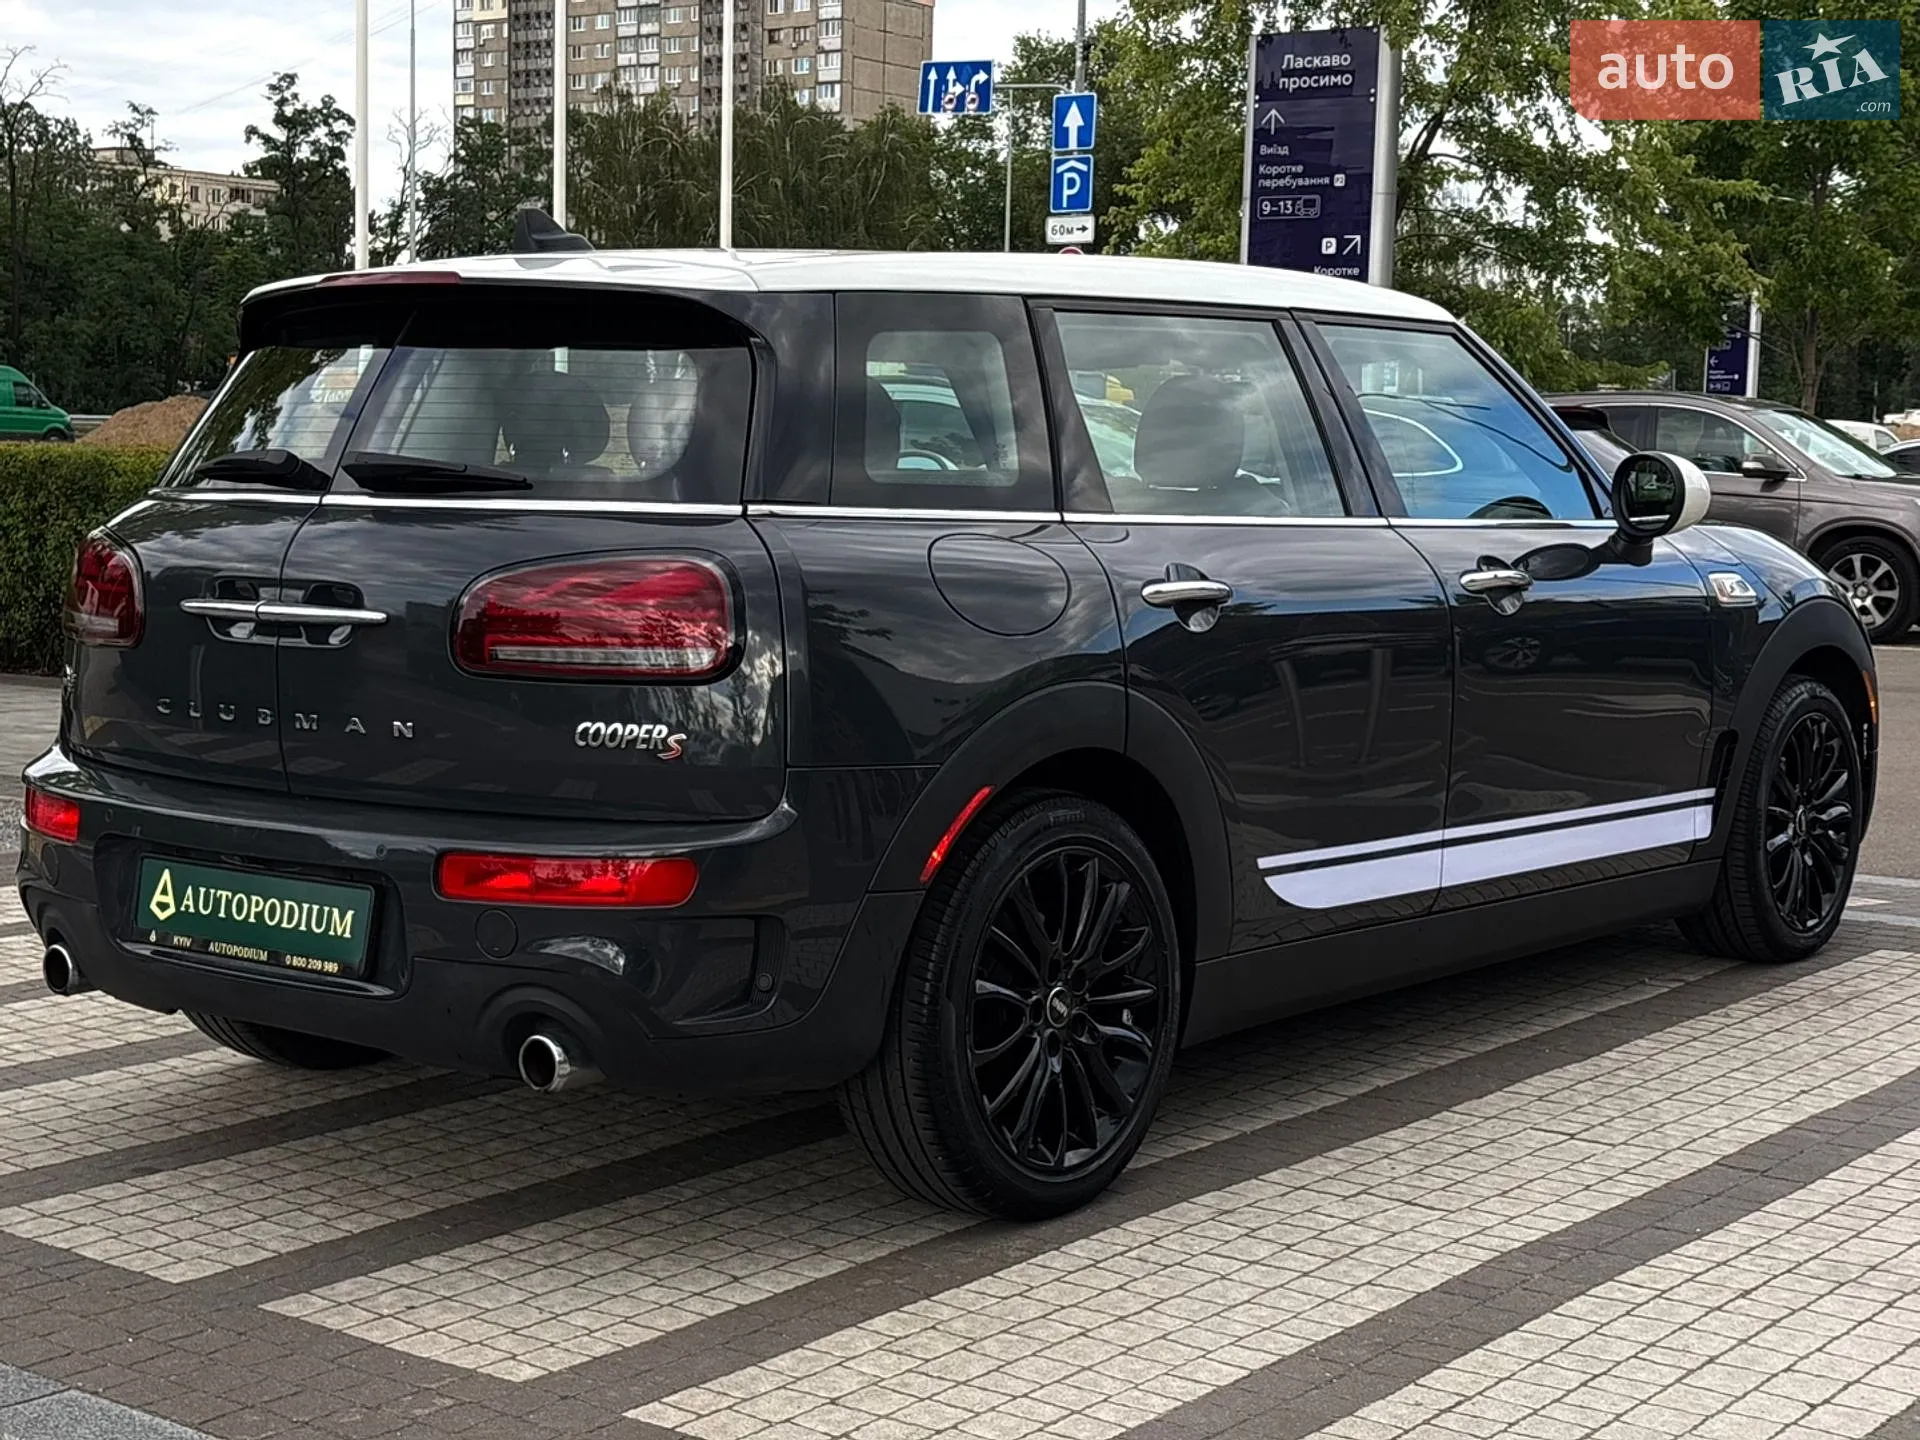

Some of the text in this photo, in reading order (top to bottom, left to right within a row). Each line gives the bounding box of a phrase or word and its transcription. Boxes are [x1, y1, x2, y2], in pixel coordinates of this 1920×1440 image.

[1281, 53, 1351, 71] Ласкаво
[1279, 73, 1353, 93] просимо
[1260, 144, 1289, 156] Виїзд
[1259, 164, 1304, 177] Коротке
[1062, 171, 1081, 208] P
[1258, 175, 1331, 190] перебування
[1325, 239, 1334, 252] P
[1313, 265, 1360, 277] Коротке
[156, 698, 414, 739] CLUBMAN
[574, 721, 688, 760] COOPER S
[180, 885, 355, 938] AUTOPODIUM
[173, 935, 193, 948] KYIV
[208, 941, 269, 961] AUTOPODIUM
[285, 954, 292, 965] 0
